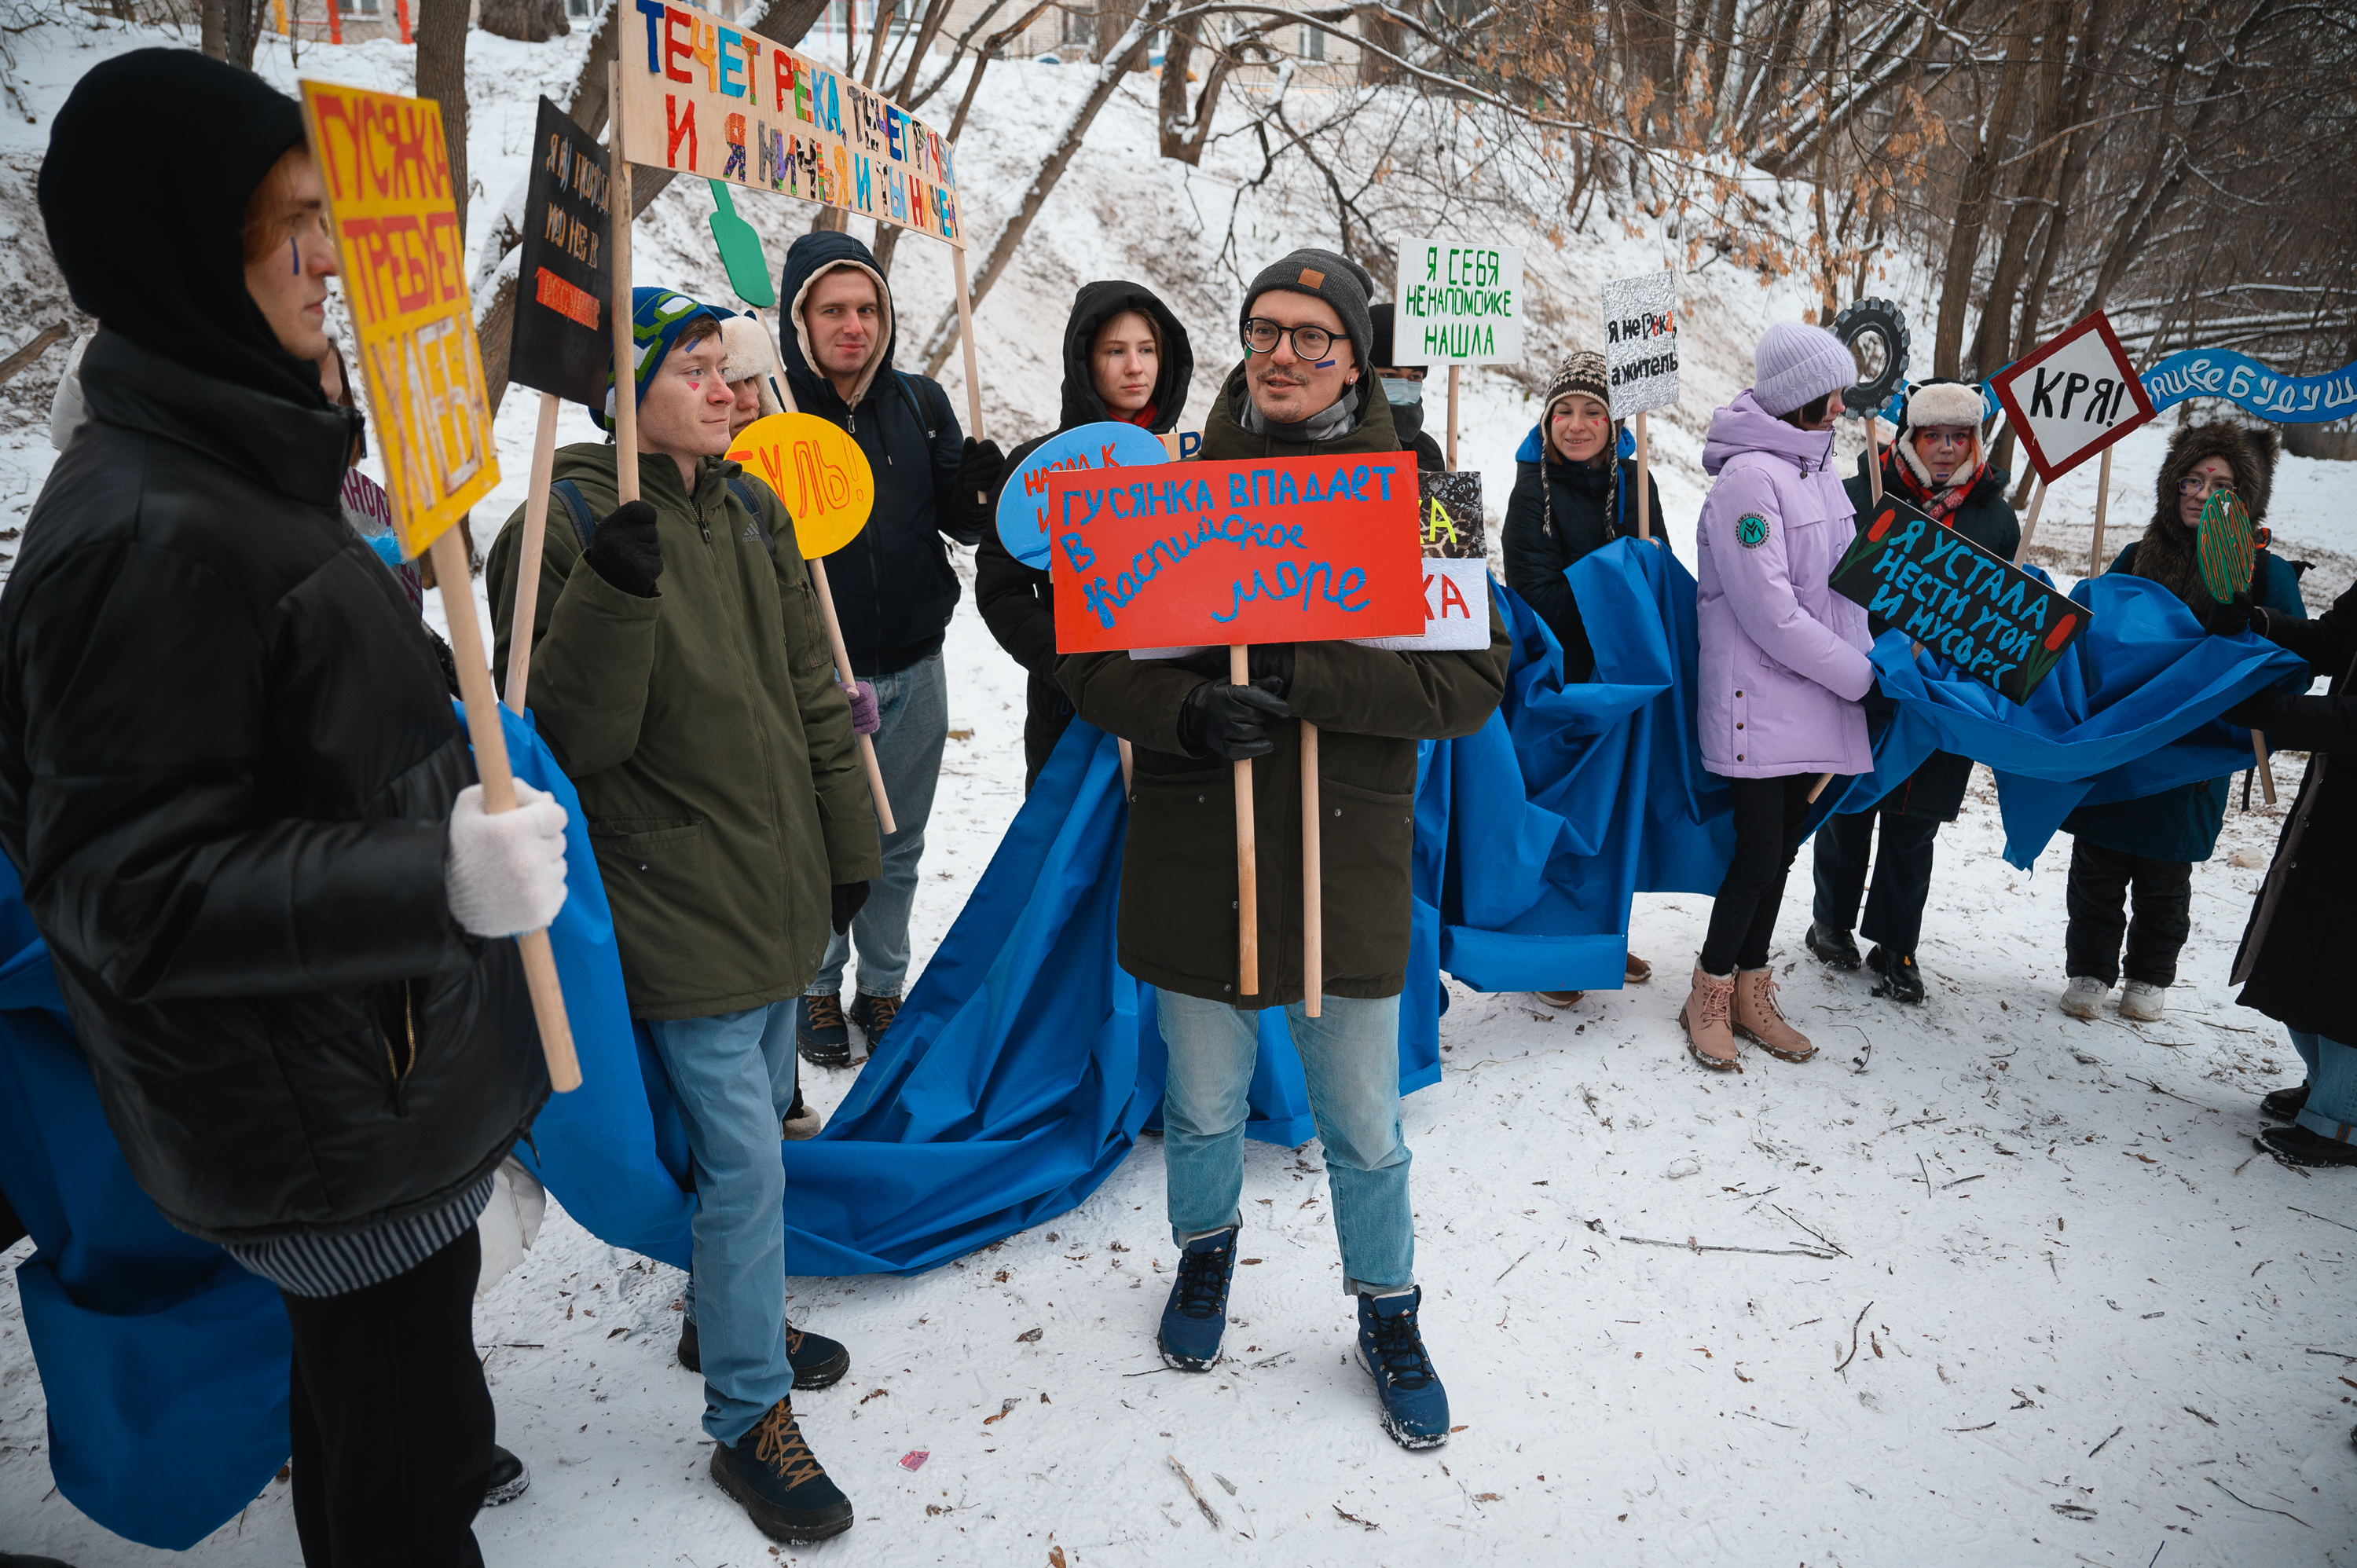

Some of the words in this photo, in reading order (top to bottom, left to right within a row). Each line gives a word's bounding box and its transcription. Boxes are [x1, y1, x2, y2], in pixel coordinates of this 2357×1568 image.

[637, 0, 761, 105] ТЕЧЕТ
[847, 85, 911, 163] ТЕЧЕТ
[546, 133, 559, 173] Я
[665, 93, 697, 172] И
[724, 112, 746, 182] Я
[854, 152, 873, 212] И
[876, 161, 907, 223] ТЫ
[545, 201, 566, 247] НО
[566, 216, 588, 262] НЕ
[343, 211, 465, 324] ТРЕБУЕТ
[1427, 246, 1438, 281] Я
[1449, 248, 1500, 287] СЕБЯ
[1424, 323, 1494, 358] НАШЛА
[2030, 367, 2125, 427] КРЯ!
[1062, 478, 1215, 526] ГУСЯНКА
[1059, 532, 1097, 573] В
[1888, 520, 1926, 553] Я
[1920, 530, 2048, 630] УСТАЛА
[1868, 584, 1904, 620] И
[1872, 548, 1970, 621] НЕСТИ
[1970, 605, 2036, 661] УТОК
